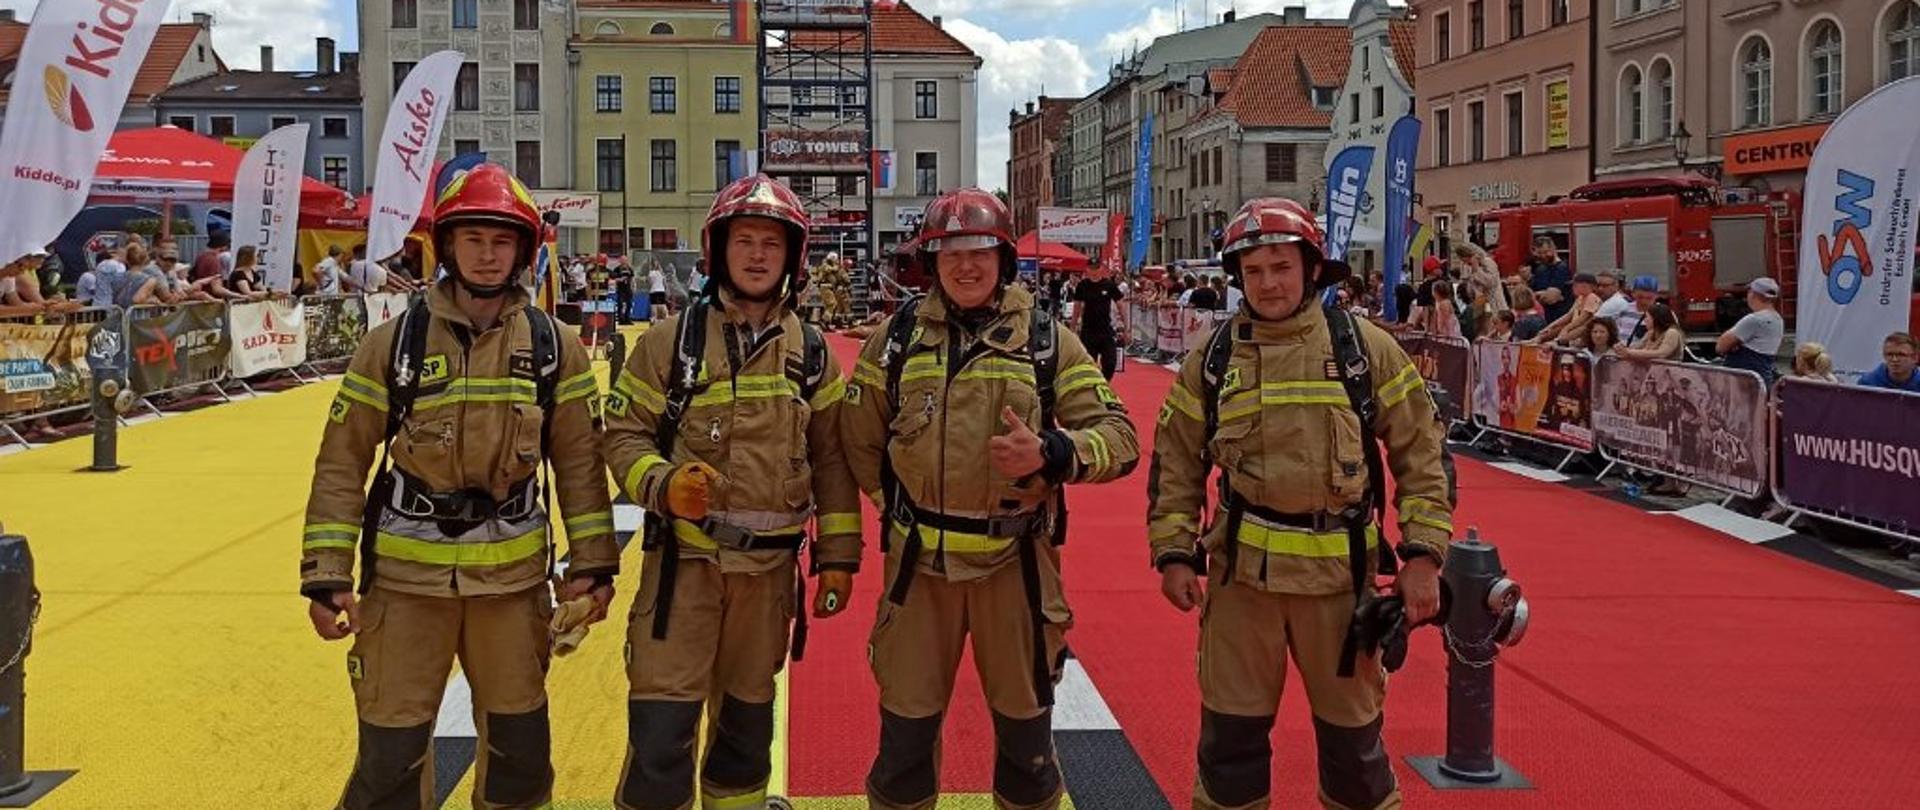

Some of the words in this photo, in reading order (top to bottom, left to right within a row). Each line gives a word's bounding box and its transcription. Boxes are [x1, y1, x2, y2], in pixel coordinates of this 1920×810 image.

[392, 87, 435, 183] Aisko
[805, 142, 859, 153] TOWER
[14, 165, 81, 191] Kidde.pl
